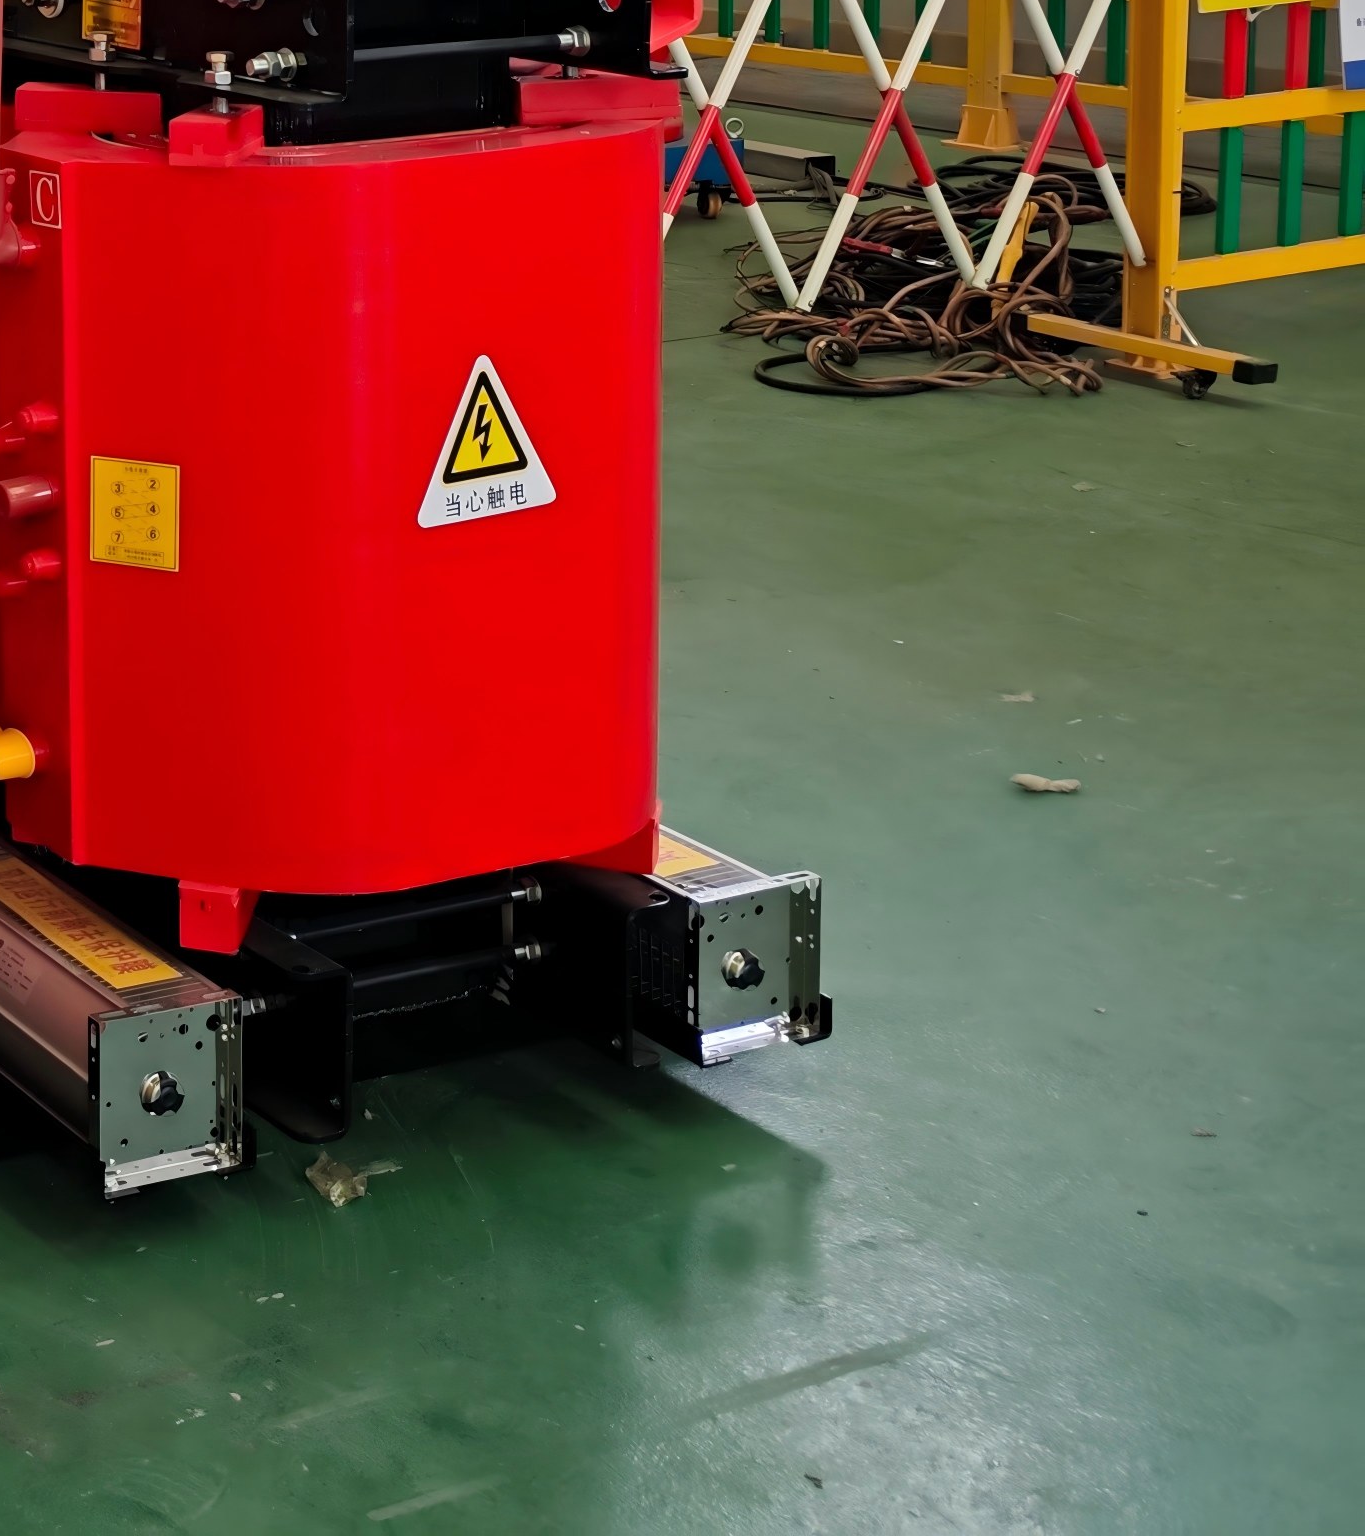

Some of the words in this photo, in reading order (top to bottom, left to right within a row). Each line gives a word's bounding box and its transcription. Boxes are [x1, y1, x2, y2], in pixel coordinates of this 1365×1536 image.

[36, 177, 55, 222] C
[445, 481, 527, 517] 当心触电
